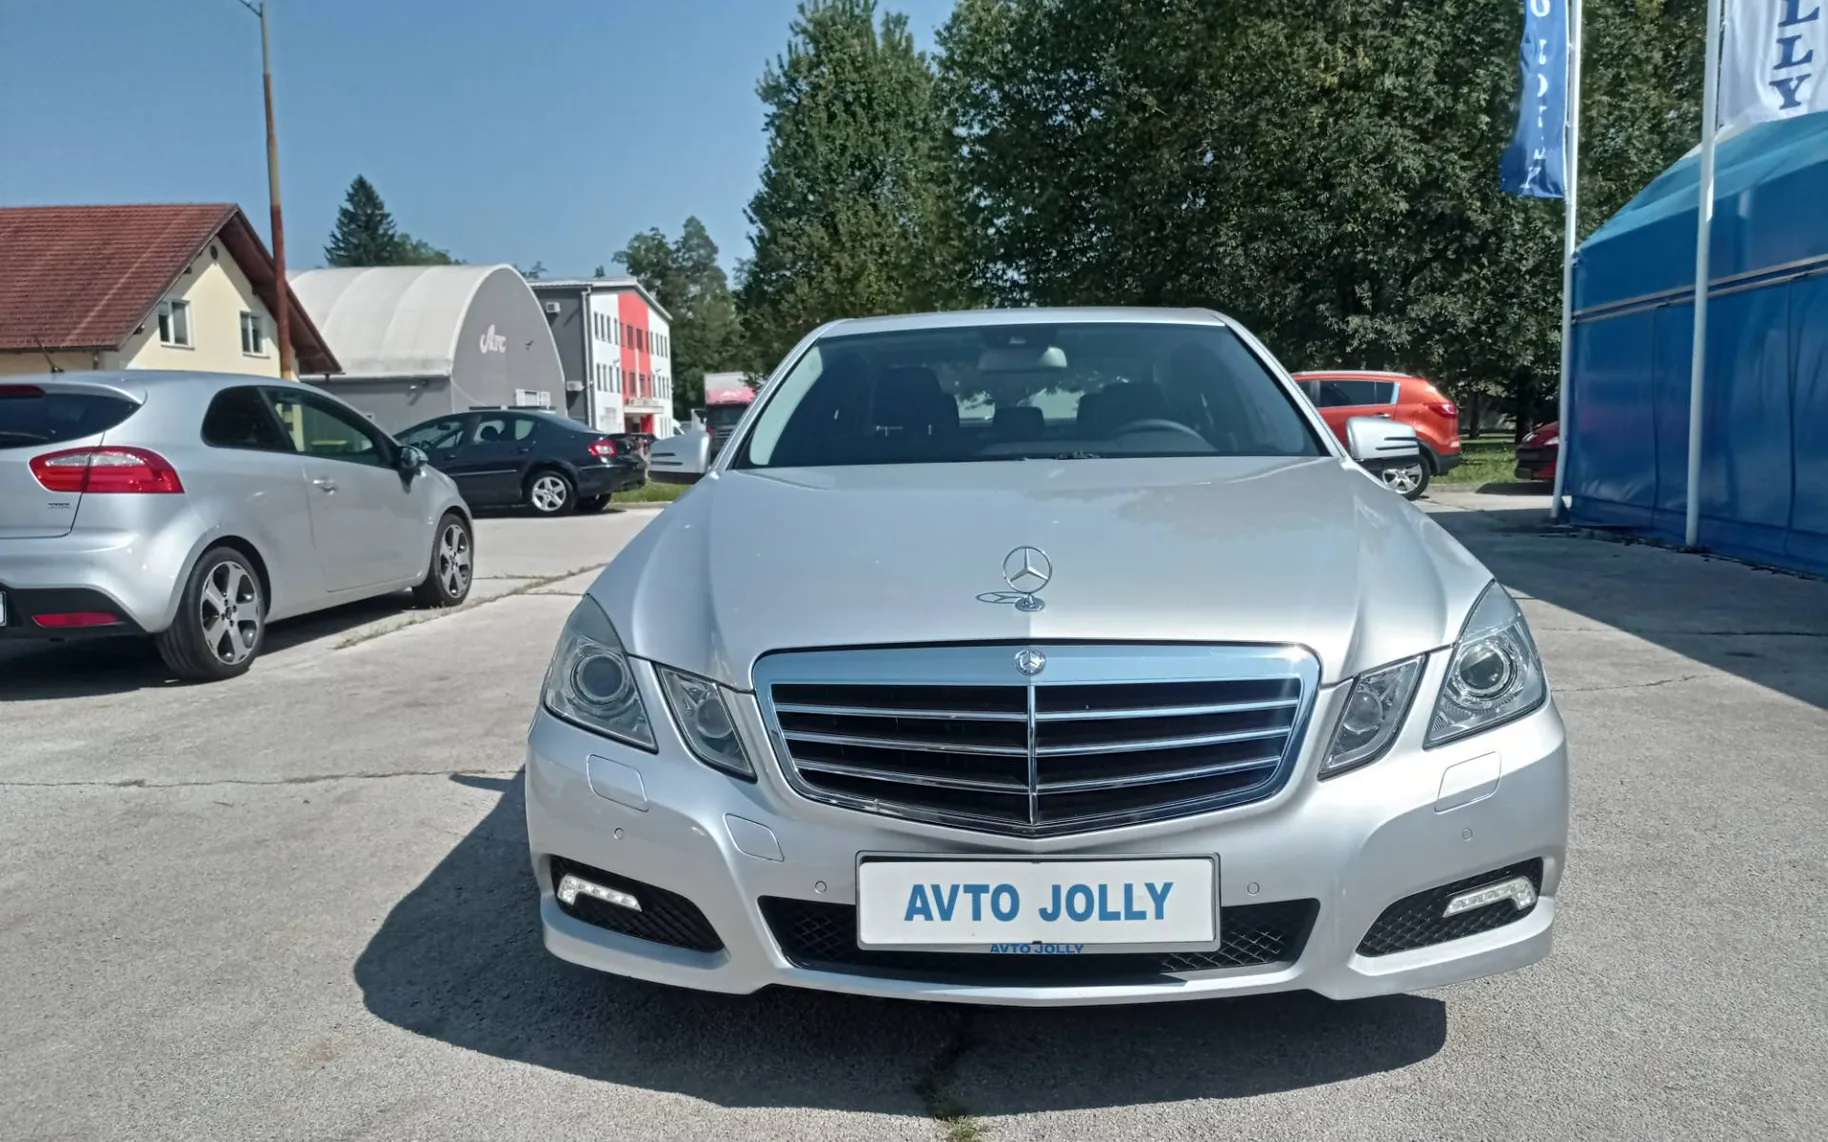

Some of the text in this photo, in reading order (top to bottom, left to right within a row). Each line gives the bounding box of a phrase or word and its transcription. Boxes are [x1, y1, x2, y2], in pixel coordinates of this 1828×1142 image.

[904, 882, 1174, 922] AVTO JOLLY
[990, 943, 1084, 954] AVTO JOLLY
